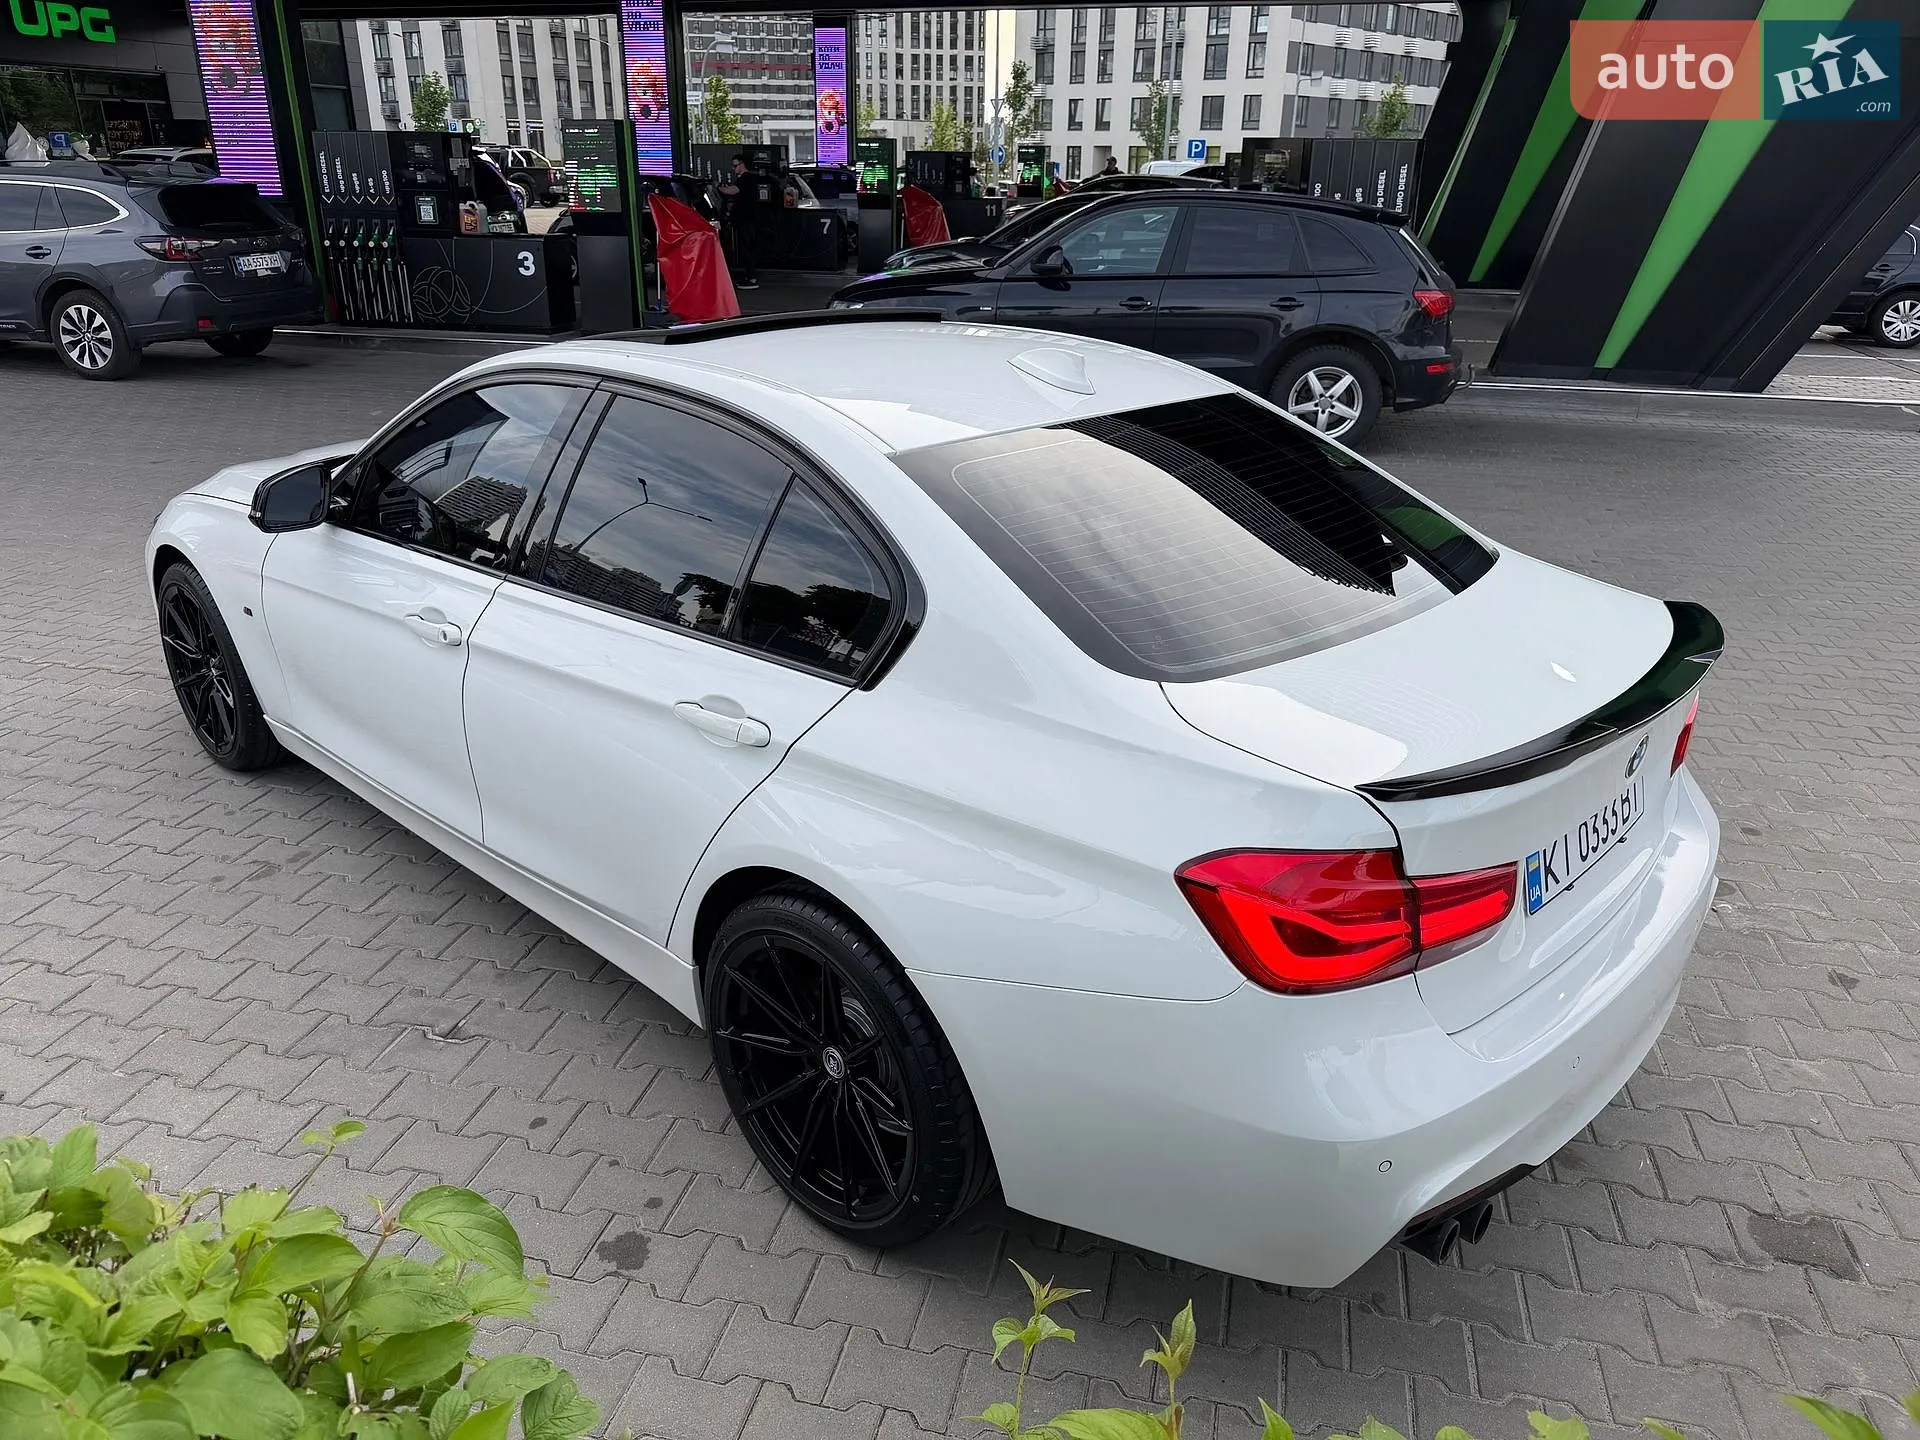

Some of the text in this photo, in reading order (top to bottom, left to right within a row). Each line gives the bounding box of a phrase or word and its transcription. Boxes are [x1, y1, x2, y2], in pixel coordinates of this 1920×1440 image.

[9, 0, 116, 43] UPG
[1191, 141, 1203, 157] P
[319, 150, 330, 193] EURO DIESEL
[335, 156, 343, 180] DIESEL
[1376, 169, 1387, 197] DIESEL
[1395, 163, 1408, 213] EURO DIESEL
[985, 204, 996, 217] 11
[820, 218, 832, 235] 7
[517, 250, 536, 276] 3
[1543, 833, 1571, 893] KI
[1530, 887, 1541, 901] UA
